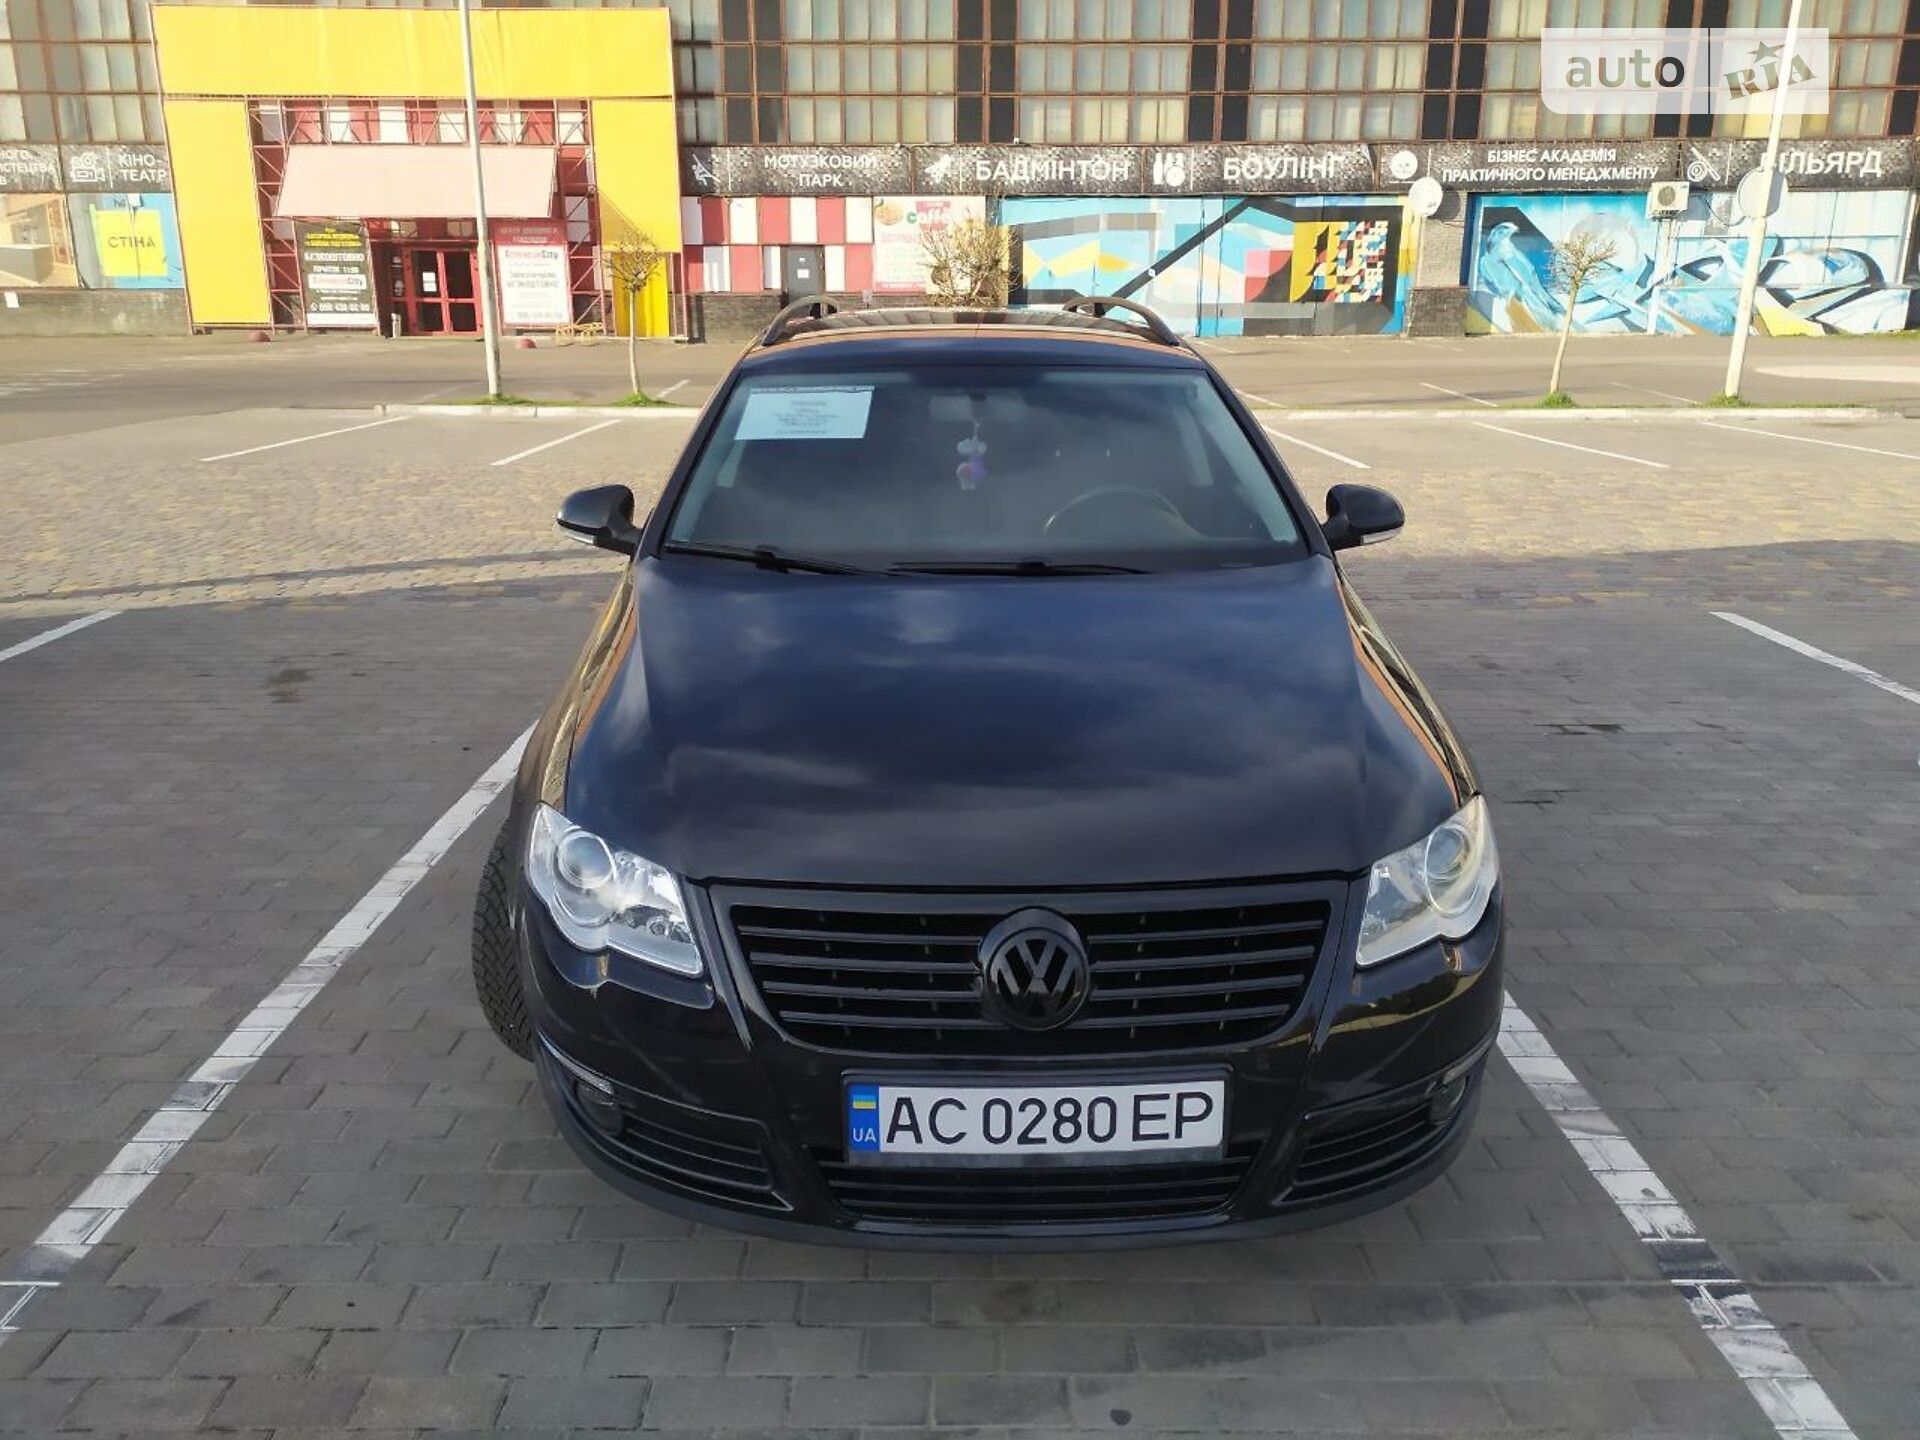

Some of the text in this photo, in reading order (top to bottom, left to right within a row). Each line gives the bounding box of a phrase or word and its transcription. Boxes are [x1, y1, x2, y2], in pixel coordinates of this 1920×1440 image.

[1487, 148, 1617, 163] БІЗНЕС АКАДЕМІЯ
[975, 158, 1130, 183] БАДМІНТОН
[1223, 155, 1346, 181] БОУЛІНГ
[1442, 166, 1659, 183] ПРАКТИЧНОГО МЕНЕДЖМЕНТУ
[119, 169, 168, 183] ТЕАТР
[799, 173, 845, 187] ПАРК
[107, 236, 156, 248] СТІНА
[885, 1090, 1215, 1146] AC 0280 EP
[852, 1128, 877, 1143] UA
